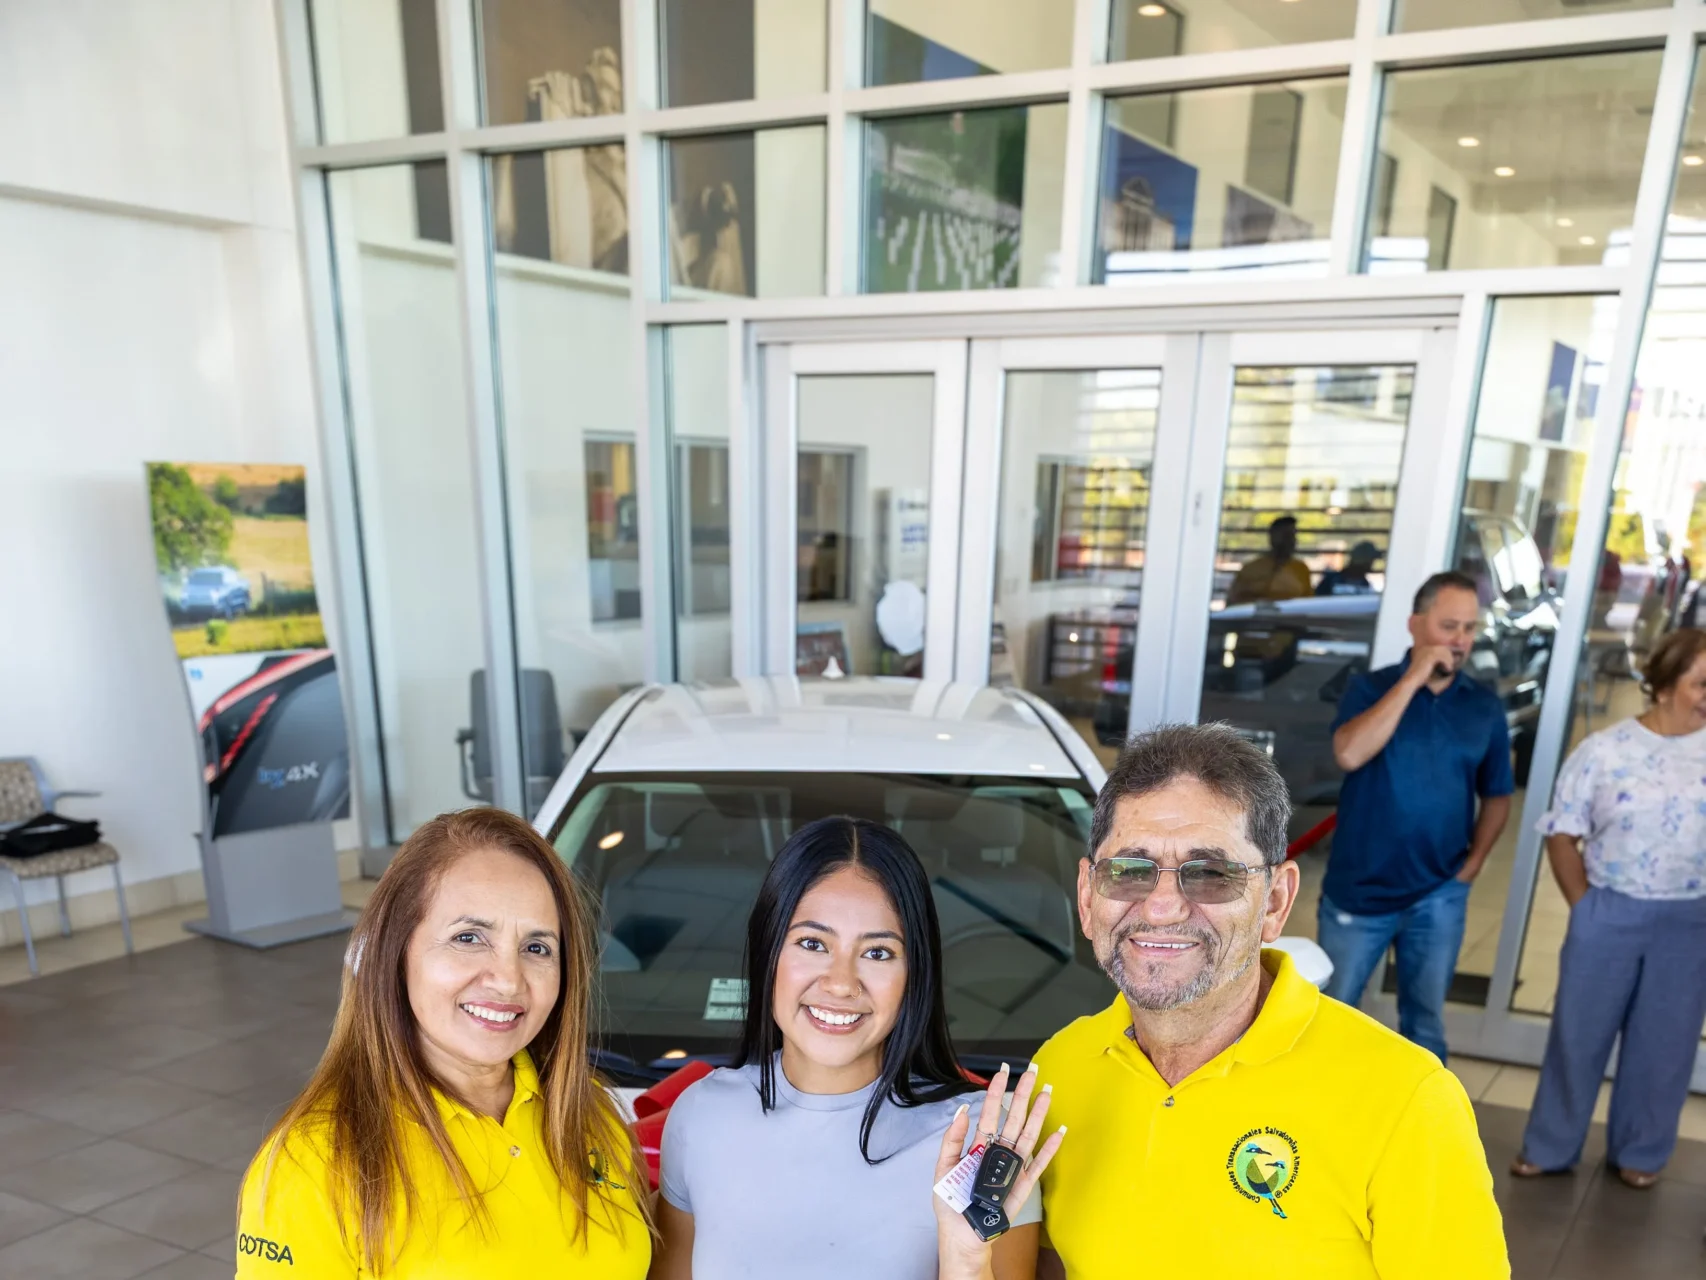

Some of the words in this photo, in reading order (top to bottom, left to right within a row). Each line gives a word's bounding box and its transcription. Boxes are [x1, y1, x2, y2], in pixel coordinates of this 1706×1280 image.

[1226, 1128, 1262, 1169] Transnacionales
[1265, 1126, 1298, 1154] Salvadoreñas
[1282, 1156, 1300, 1194] Americanas
[239, 1233, 293, 1266] COTSA
